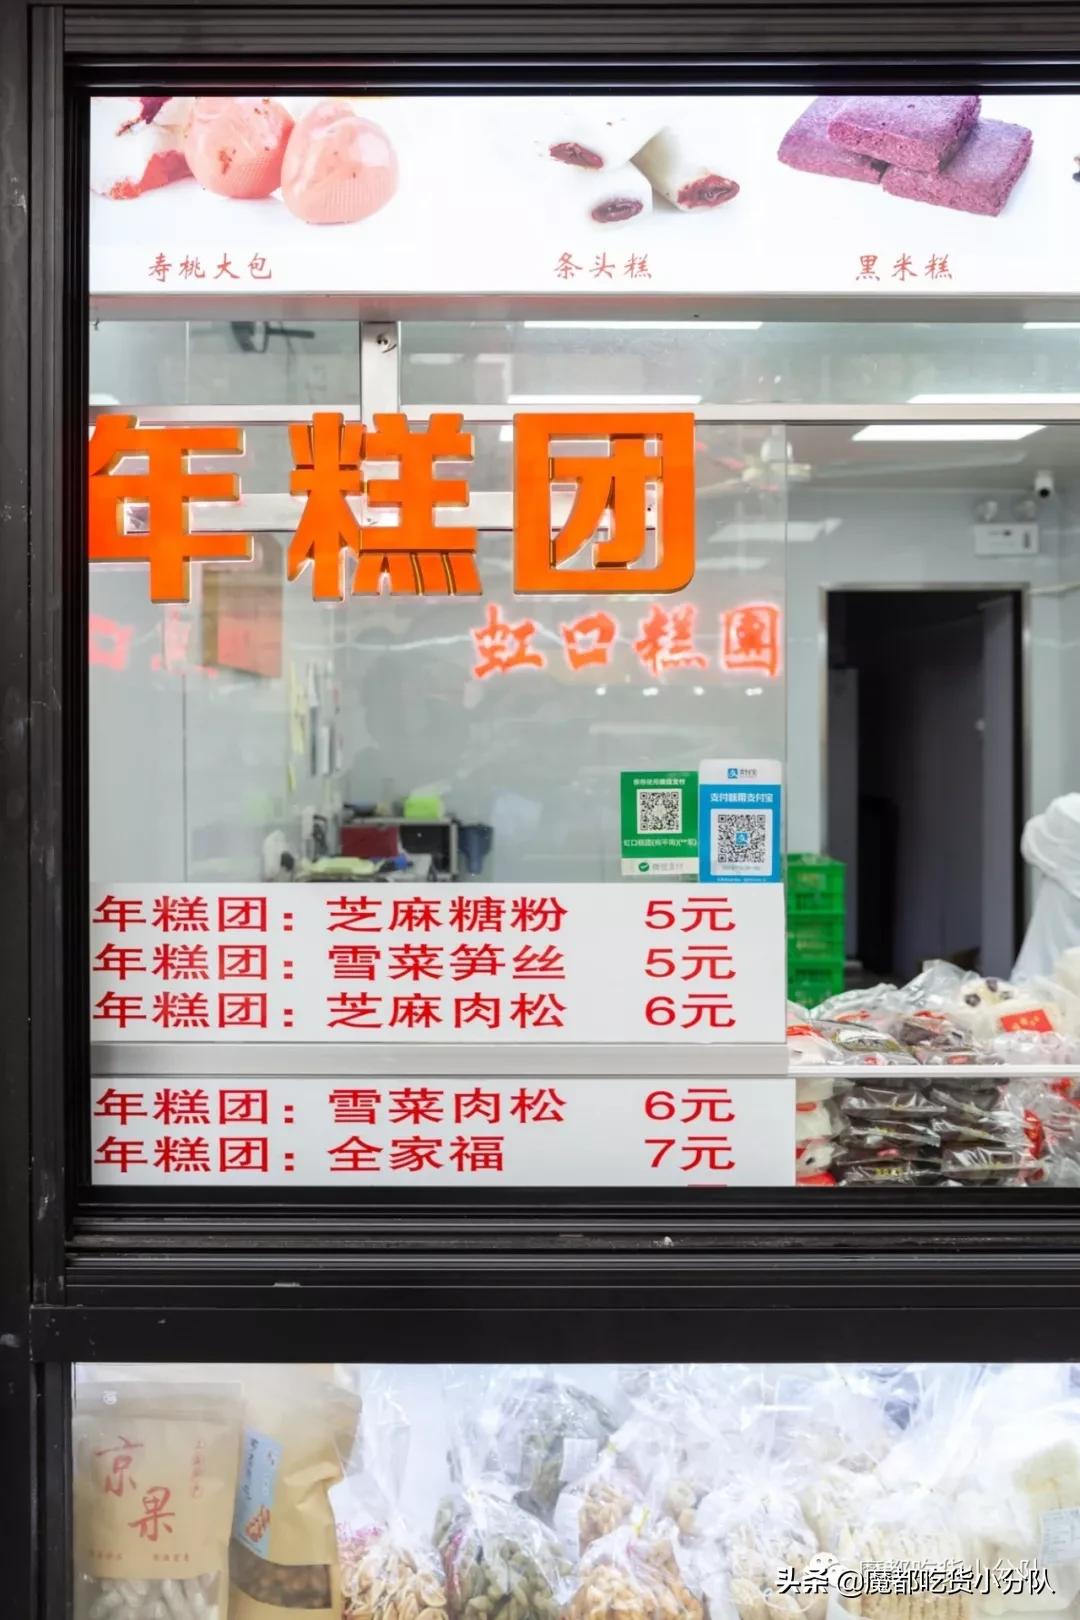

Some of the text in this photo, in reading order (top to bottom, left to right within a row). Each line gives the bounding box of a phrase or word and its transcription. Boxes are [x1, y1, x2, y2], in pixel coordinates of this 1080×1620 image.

[148, 252, 272, 282] 寿桃大包
[554, 252, 653, 281] 条头糕
[855, 253, 954, 281] 黑米糕
[88, 412, 697, 604] 年糕团
[93, 895, 737, 933] 年糕团： 芝麻糖粉 5元
[93, 943, 737, 981] 年糕团： 雪菜笋丝 5元
[93, 991, 737, 1030] 年糕团： 芝麻肉松 6元
[94, 1087, 737, 1126] 年糕团： 雪菜肉松 6元
[94, 1135, 736, 1174] 年糕团： 全家福 7元
